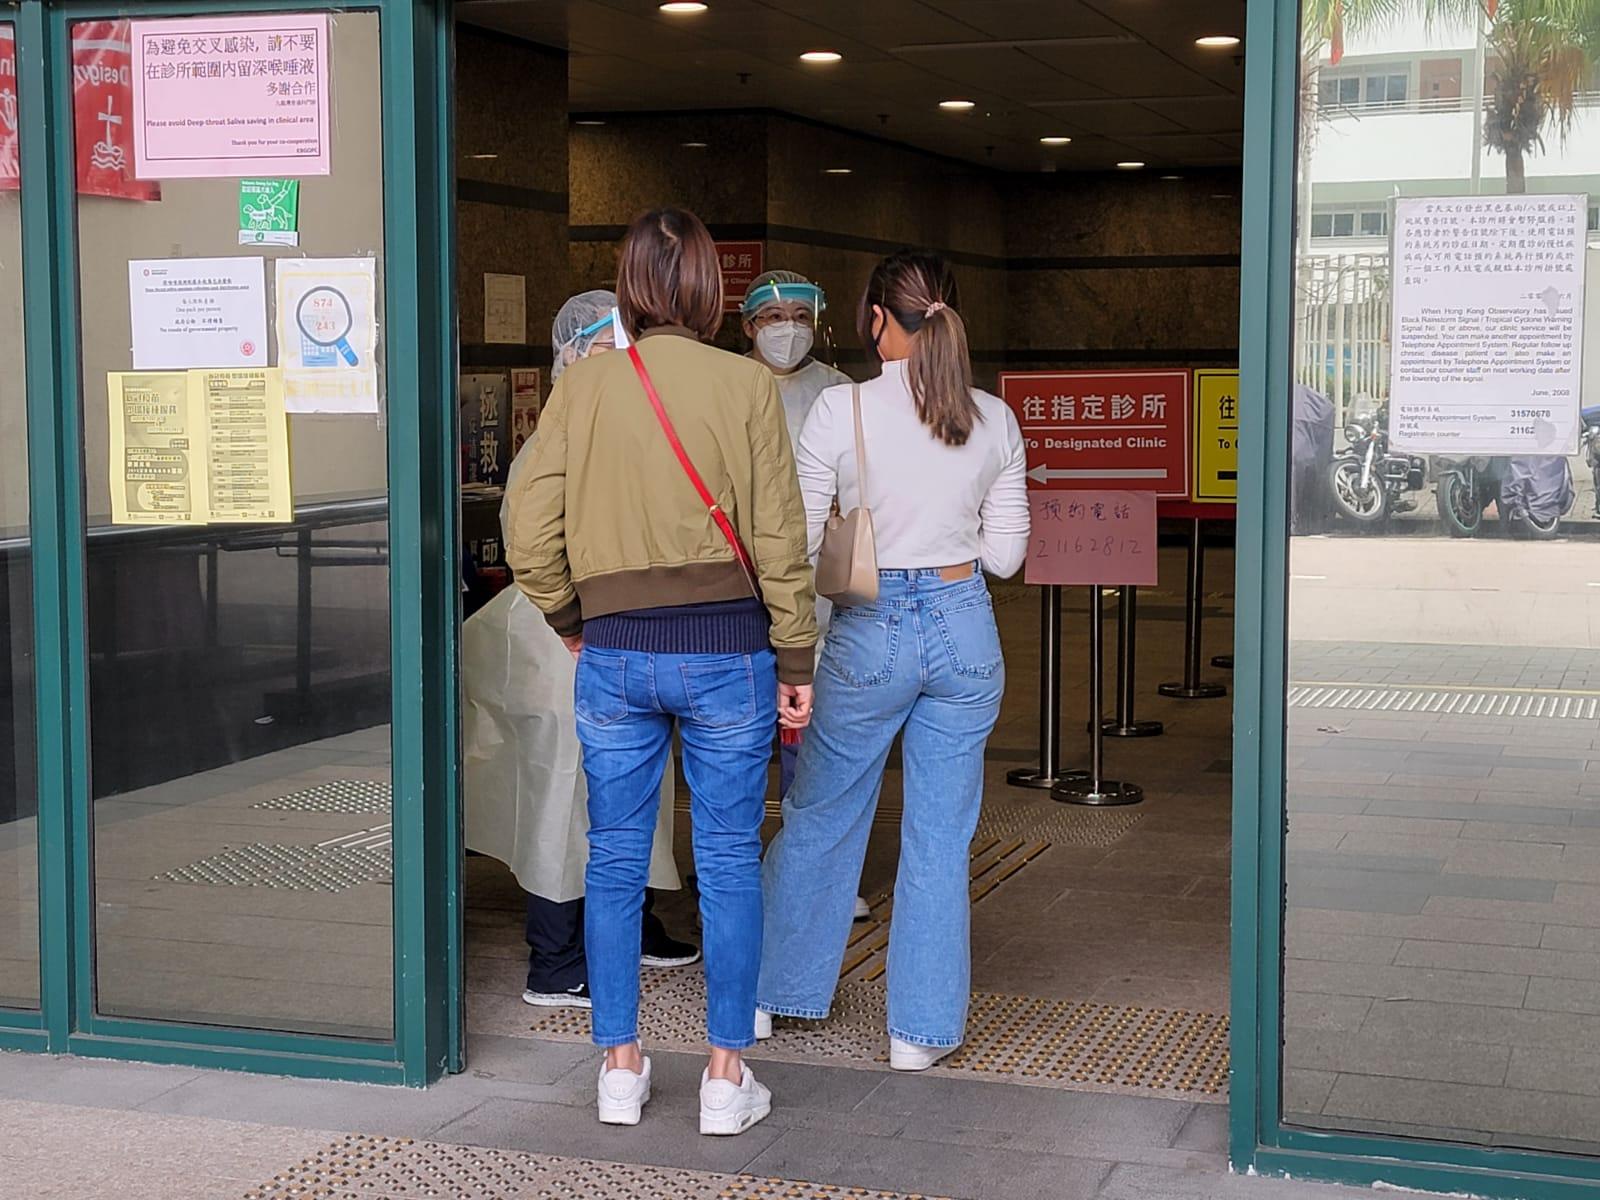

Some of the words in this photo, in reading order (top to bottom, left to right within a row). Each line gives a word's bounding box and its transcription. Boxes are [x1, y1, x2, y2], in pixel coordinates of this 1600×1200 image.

[145, 57, 315, 80] 在診所範圍內留深喉唾液
[266, 81, 316, 96] 多謝合作
[146, 119, 167, 127] Please
[168, 118, 186, 126] avoid
[187, 119, 204, 127] Deep
[227, 117, 246, 125] Saliva
[246, 117, 267, 126] saving
[268, 116, 275, 124] in
[275, 116, 298, 124] clinical
[722, 253, 752, 269] 診所
[1466, 307, 1485, 315] Kong
[1488, 307, 1530, 315] Observatory
[1457, 316, 1479, 324] Signal
[1486, 316, 1512, 324] Tropical
[1514, 316, 1542, 324] Cyclone
[1544, 316, 1573, 324] Warning
[1401, 324, 1423, 333] Signal
[1518, 333, 1562, 341] appointment
[1563, 333, 1572, 341] by
[1401, 341, 1435, 349] Telephone
[1437, 341, 1481, 349] Appointment
[1512, 341, 1539, 349] Regular
[1400, 358, 1441, 366] appointment
[1443, 358, 1452, 366] by
[1454, 358, 1489, 366] Telephone
[1490, 358, 1535, 366] Appointment
[1536, 358, 1562, 366] System
[1412, 375, 1440, 383] lowering
[1531, 389, 1551, 397] June,
[1022, 394, 1167, 421] 往指定診所
[1219, 395, 1236, 420] 往
[1400, 414, 1430, 422] Telephone
[1432, 414, 1471, 422] Appointment
[1472, 414, 1497, 423] System
[1399, 430, 1435, 438] Registration
[1510, 426, 1535, 434] 21162
[1024, 438, 1039, 449] To
[1044, 437, 1122, 451] Designated
[1126, 436, 1167, 449] Clinic
[1218, 438, 1230, 449] To
